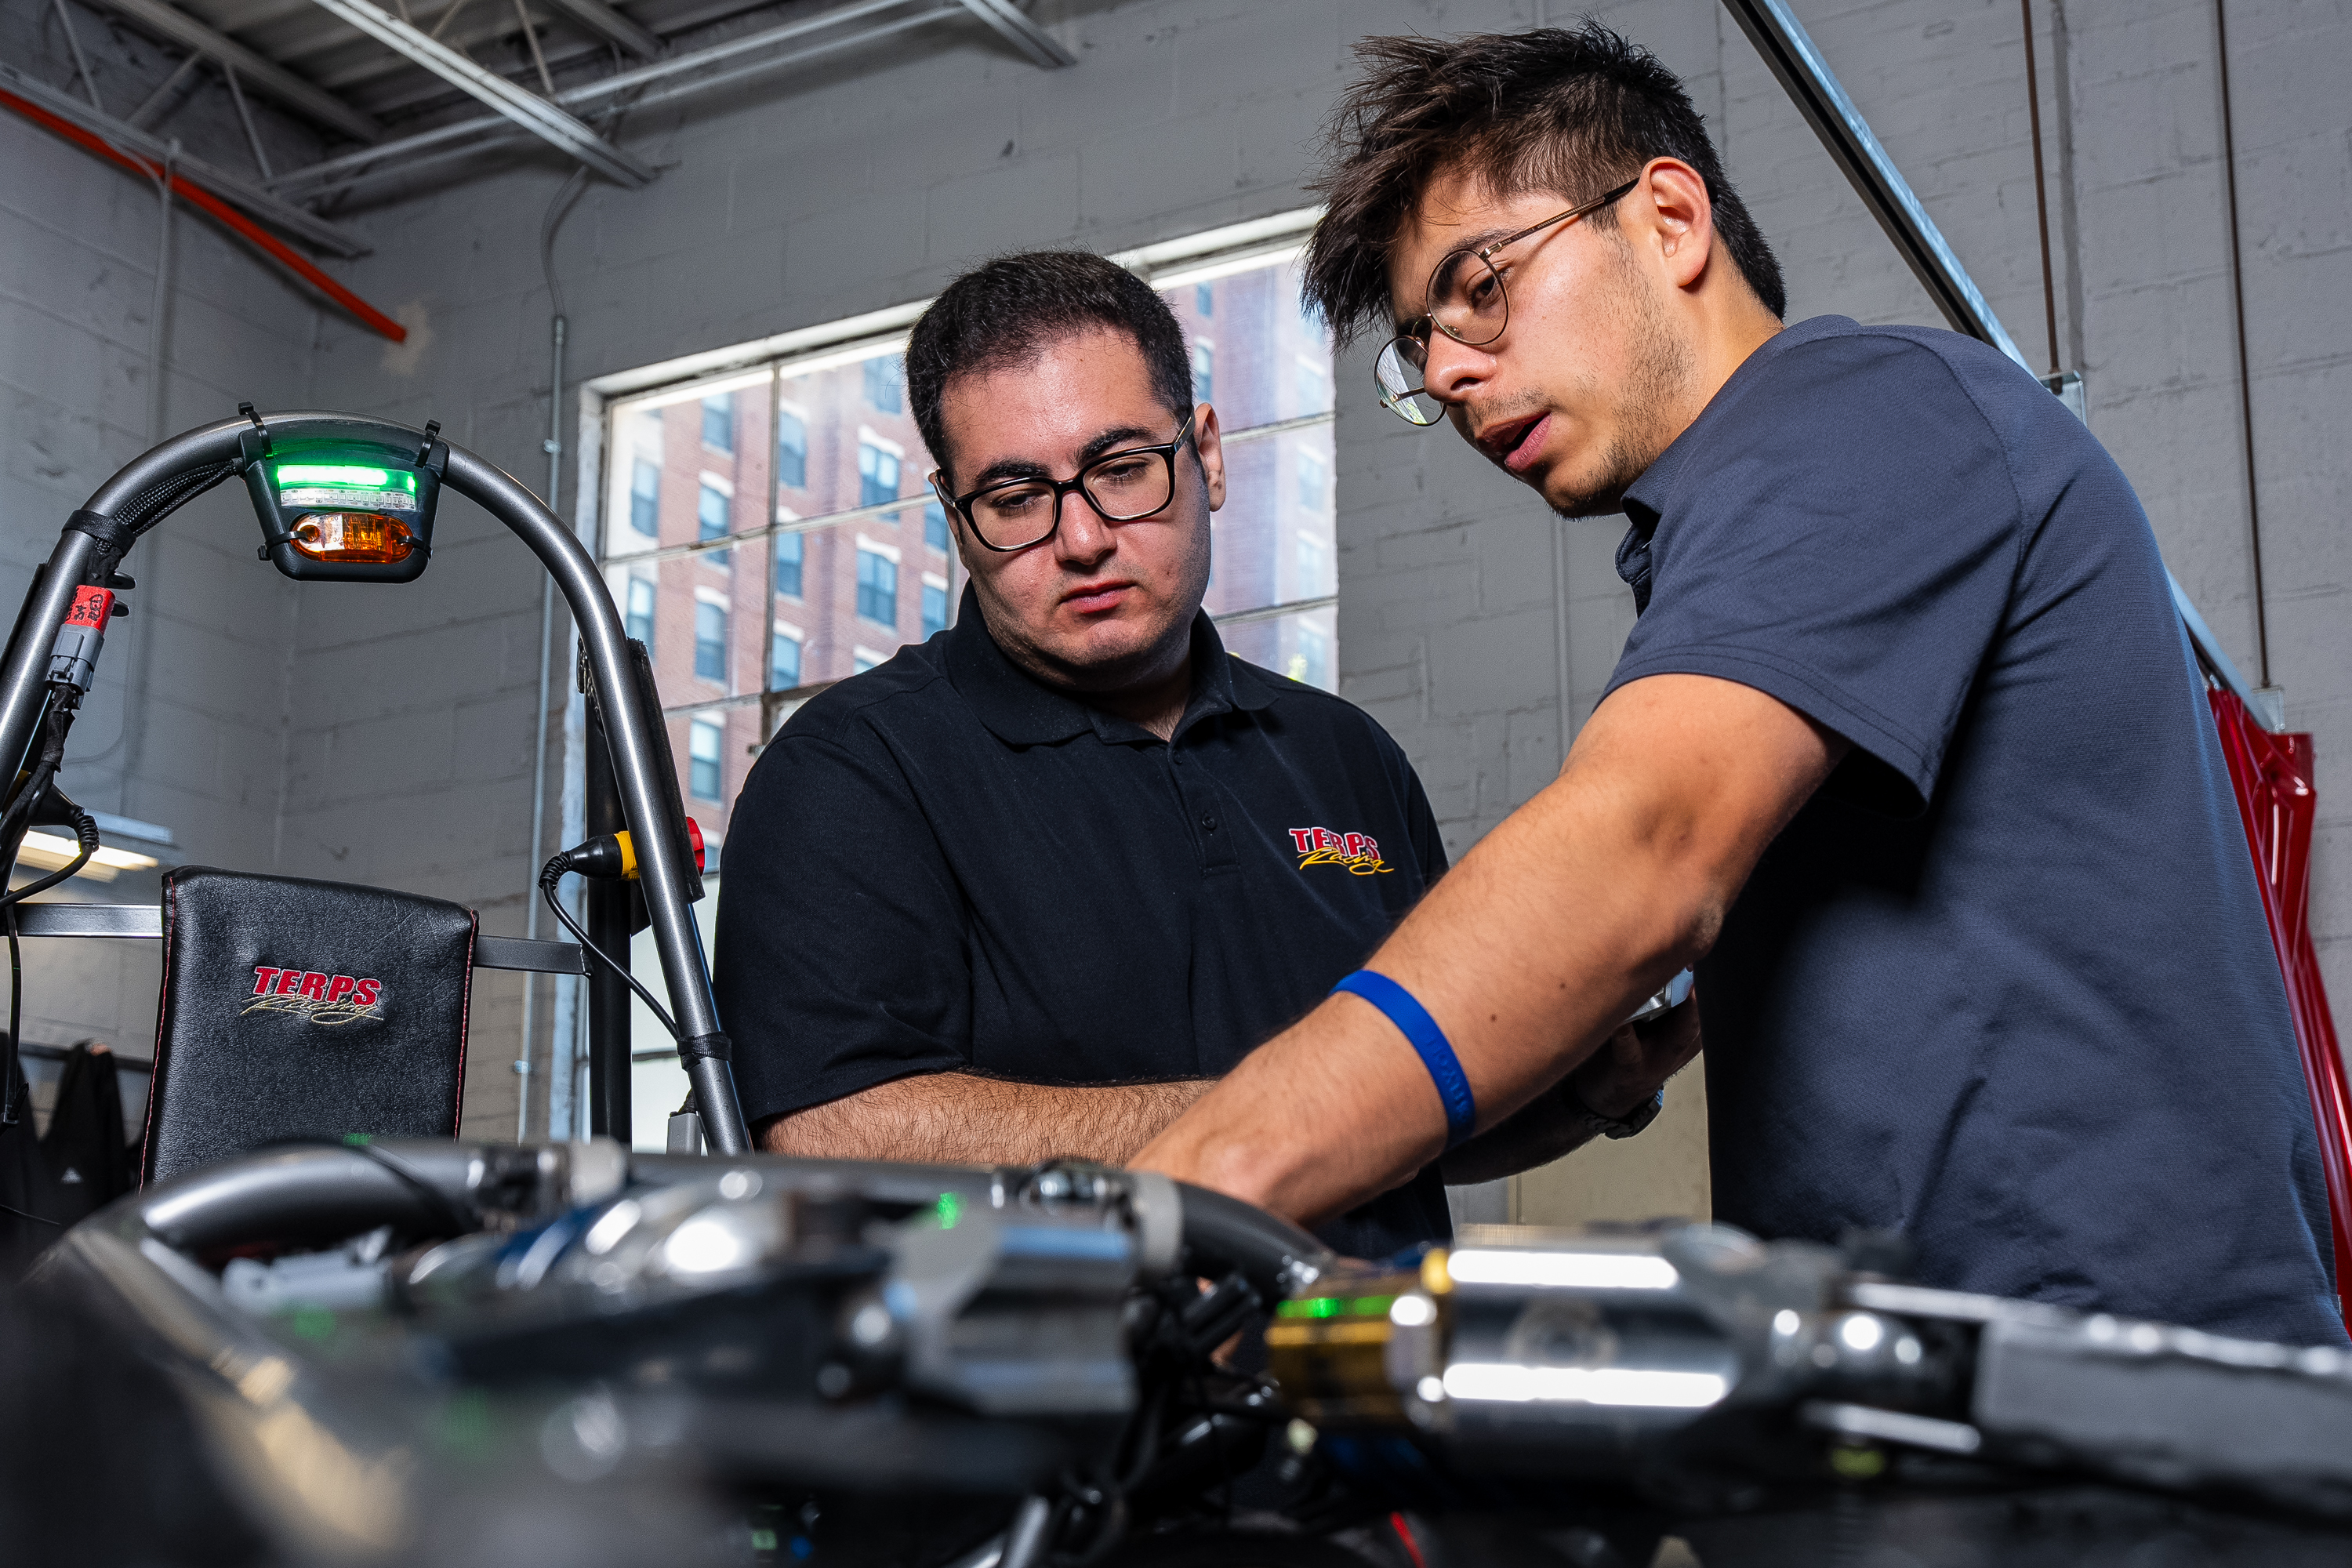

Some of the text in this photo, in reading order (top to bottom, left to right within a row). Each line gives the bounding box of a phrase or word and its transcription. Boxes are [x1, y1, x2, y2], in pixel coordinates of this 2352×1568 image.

[88, 594, 103, 621] RED
[1289, 827, 1381, 860] TERPS
[1297, 847, 1395, 876] Racing
[252, 967, 382, 1007] TERPS
[240, 993, 383, 1025] Racing
